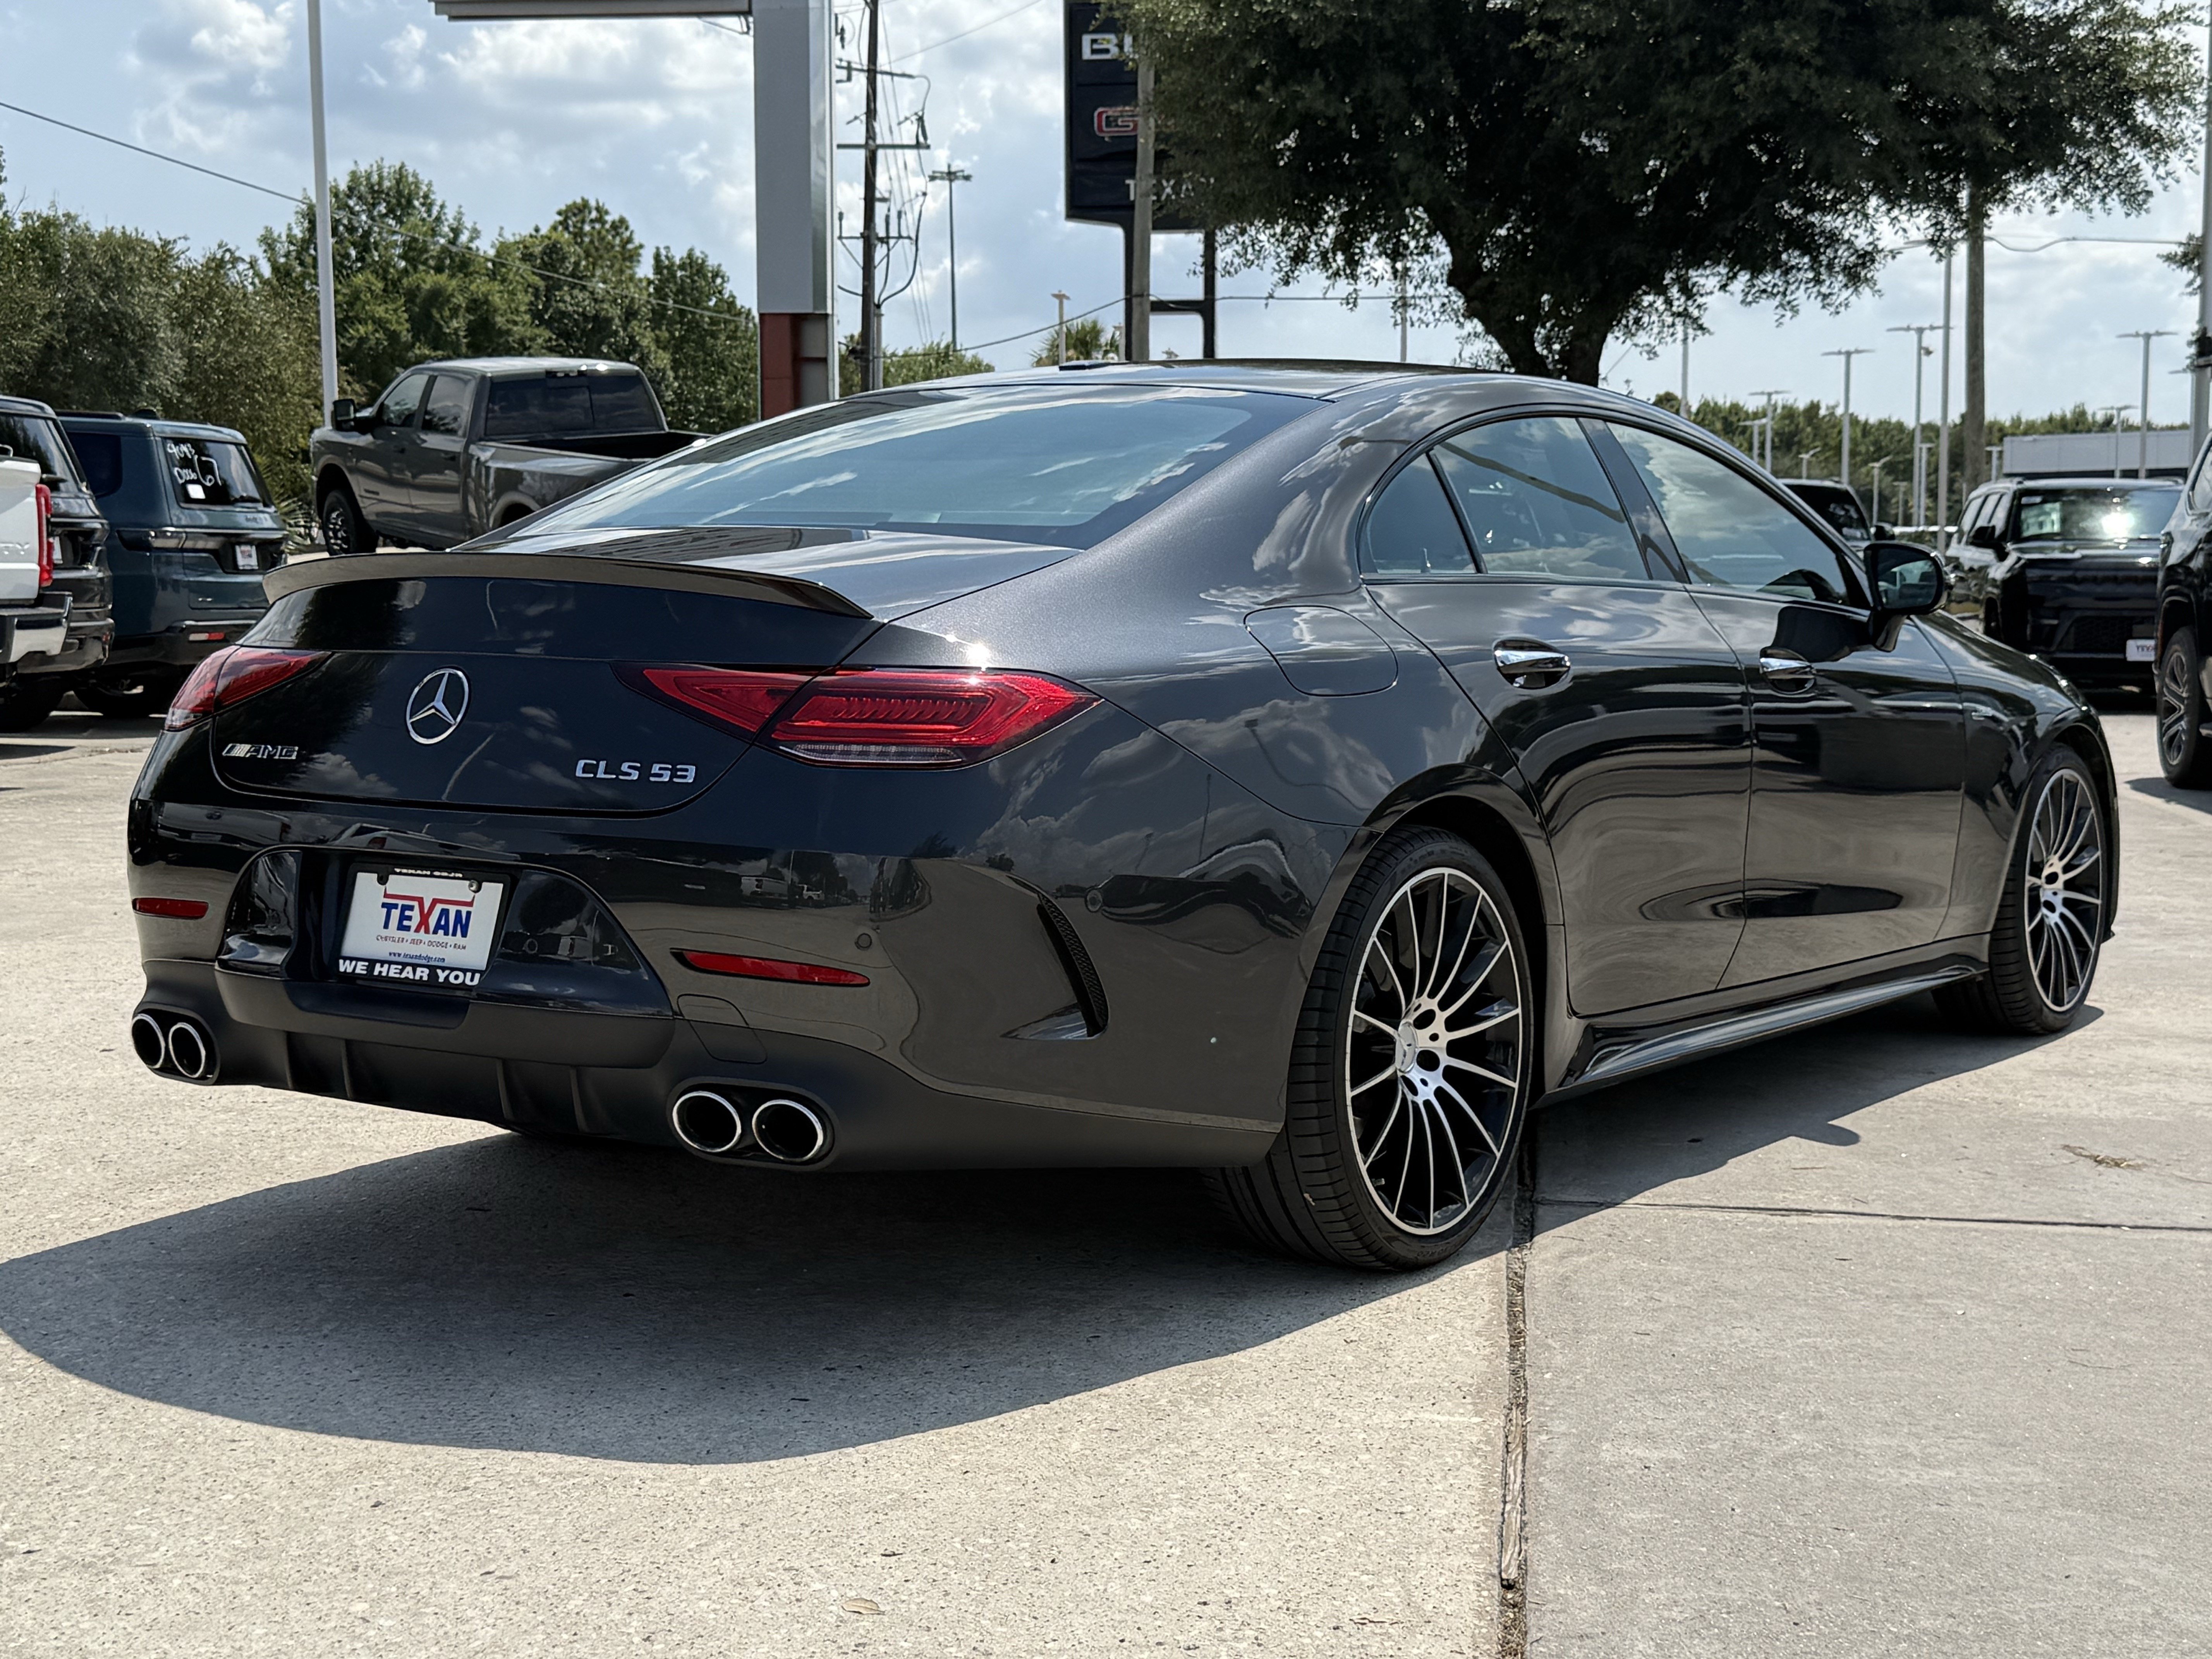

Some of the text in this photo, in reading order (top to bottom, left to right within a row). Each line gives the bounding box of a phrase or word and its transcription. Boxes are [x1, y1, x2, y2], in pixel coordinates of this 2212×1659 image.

[246, 744, 299, 759] AMG
[575, 759, 696, 783] CLS 53
[381, 891, 475, 938] TEXAN
[427, 940, 448, 949] DODGE
[339, 959, 481, 986] WE HEAR YOU
